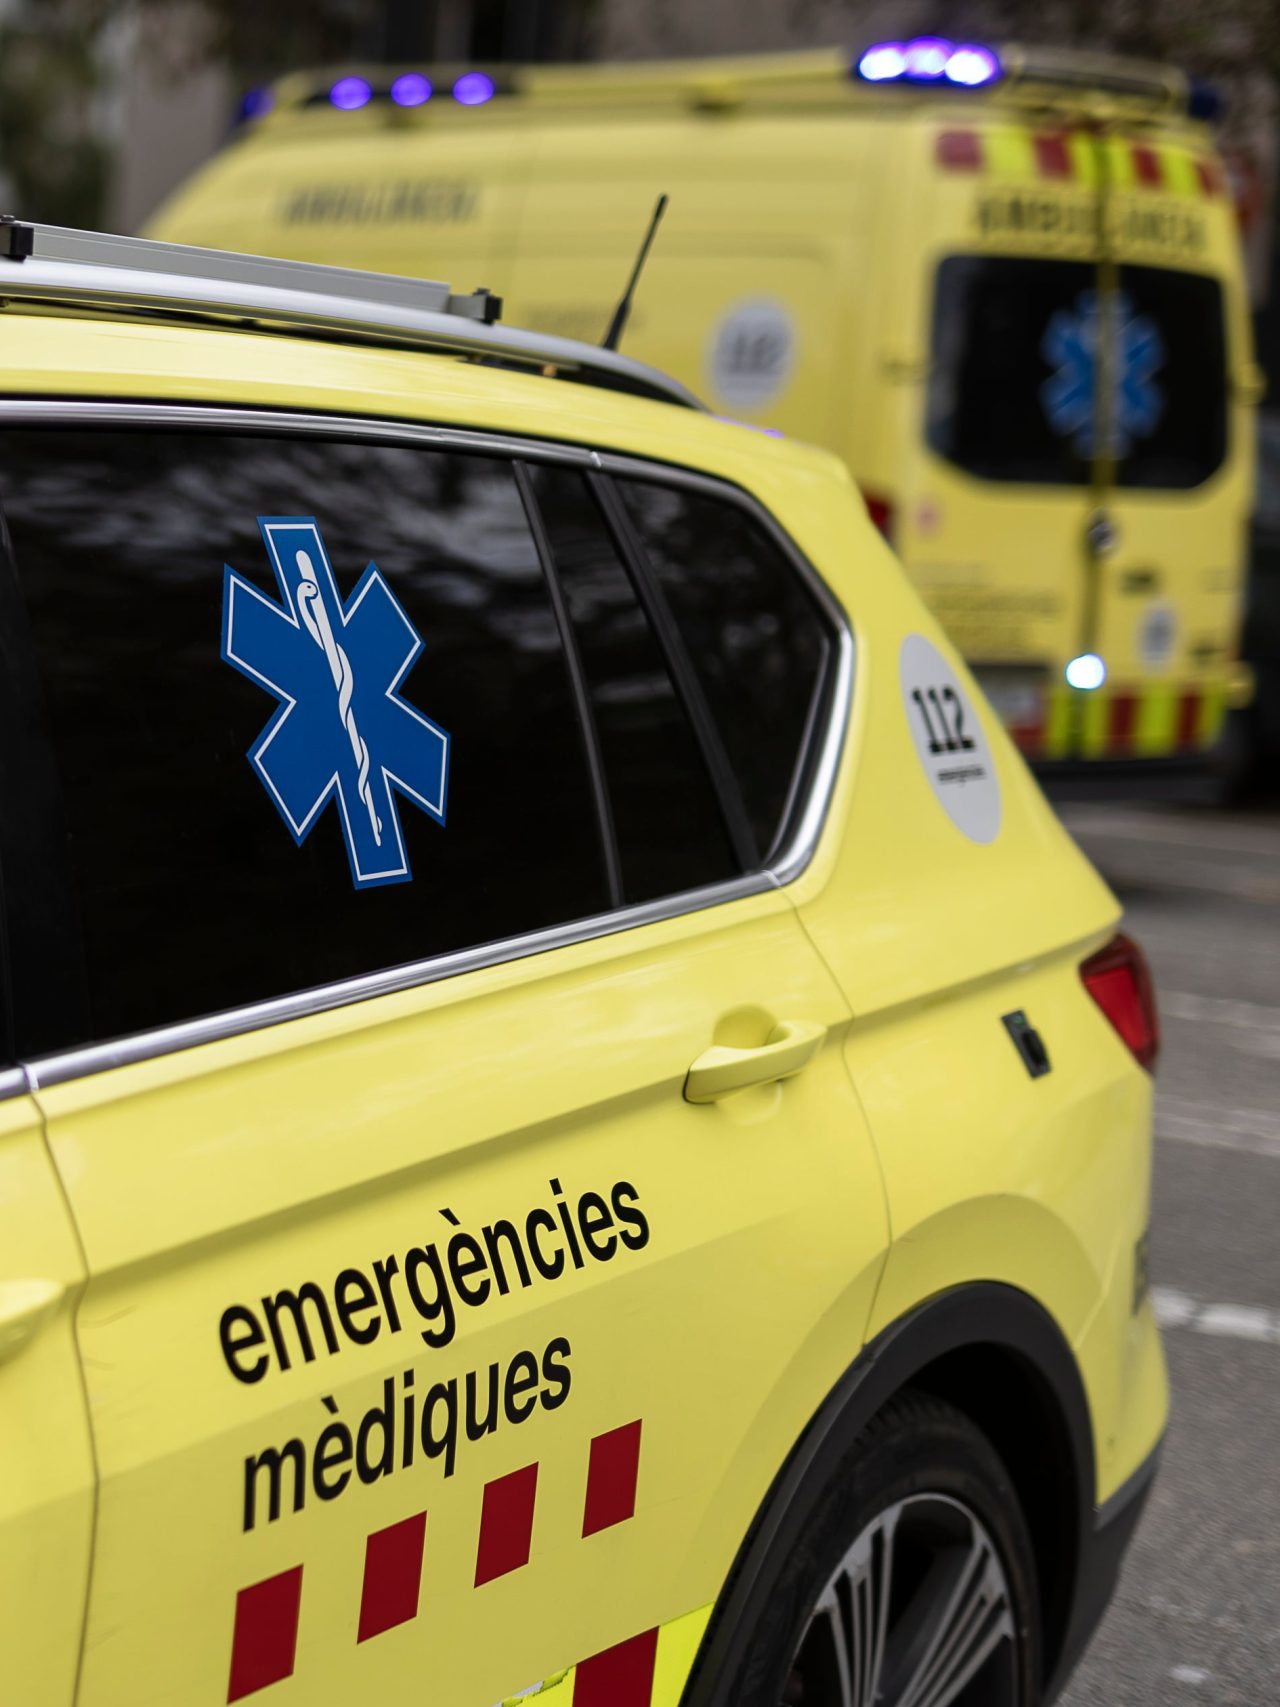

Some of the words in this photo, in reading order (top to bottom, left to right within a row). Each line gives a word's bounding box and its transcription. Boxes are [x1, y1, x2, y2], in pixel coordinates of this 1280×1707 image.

[913, 686, 975, 755] 112
[219, 1178, 650, 1385] emergències
[243, 1337, 572, 1534] mèdiques
